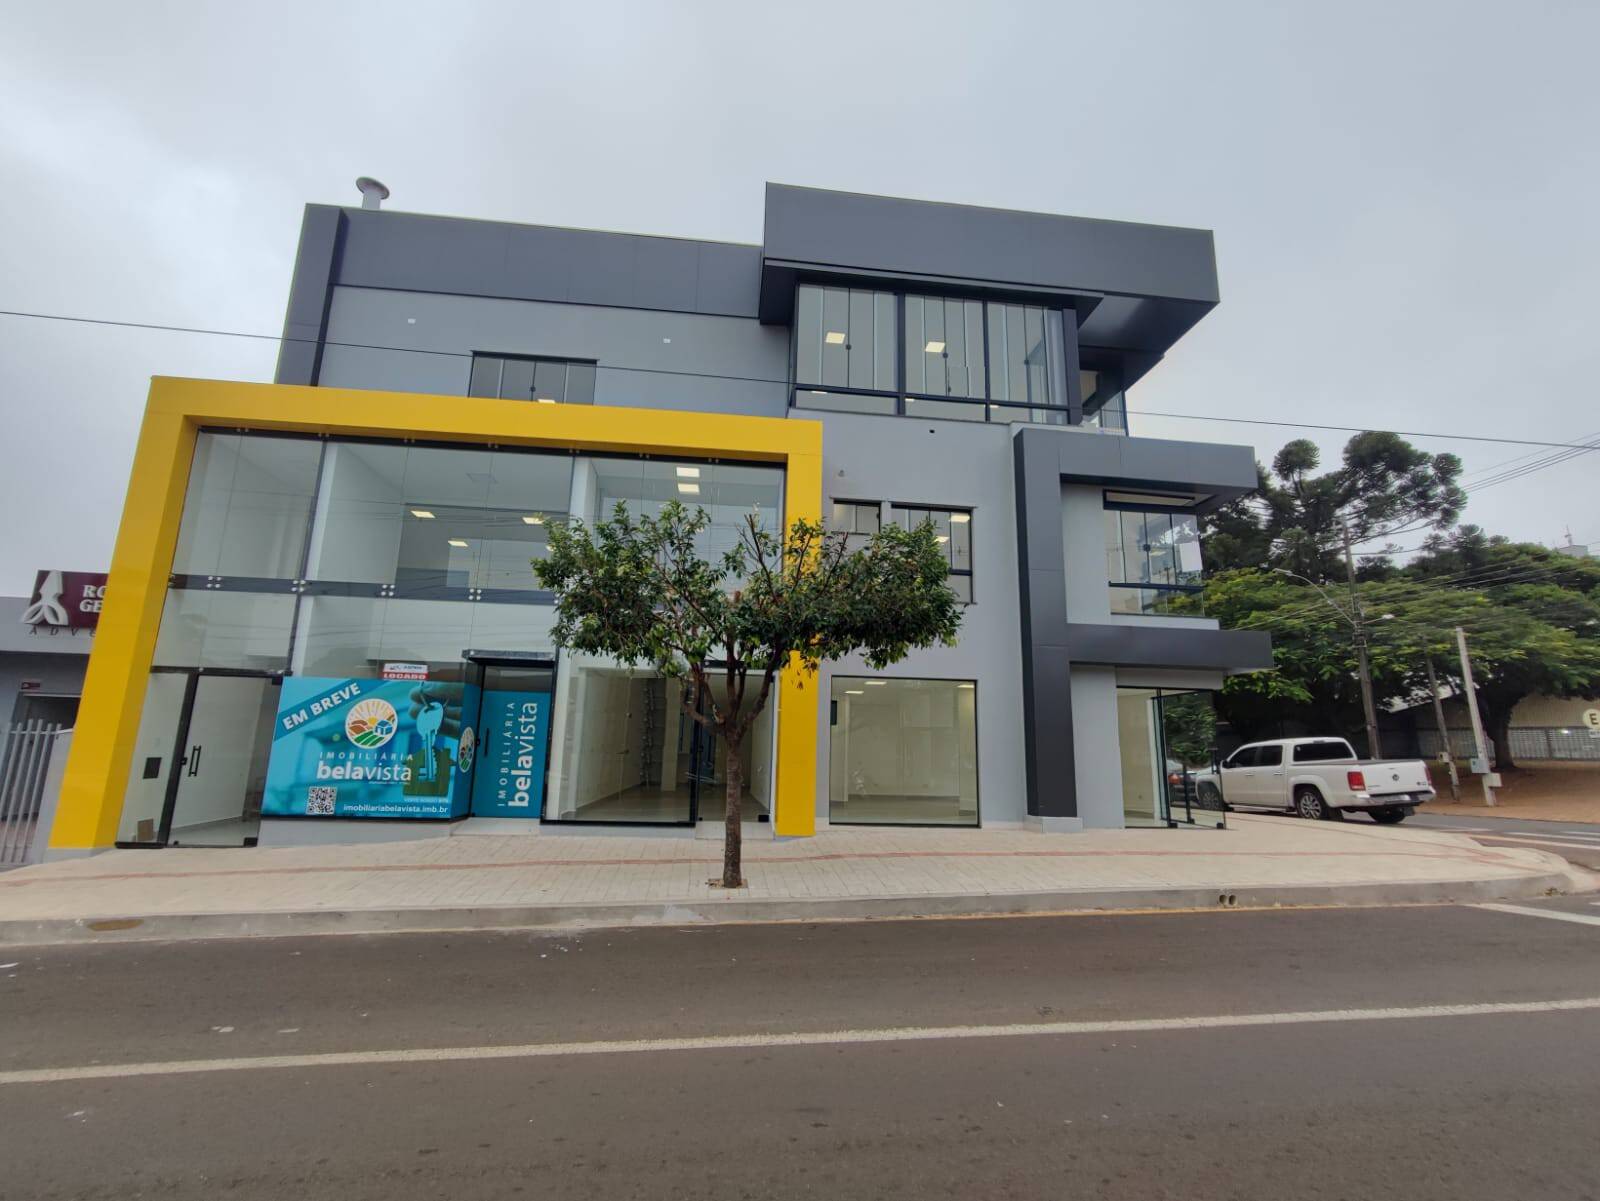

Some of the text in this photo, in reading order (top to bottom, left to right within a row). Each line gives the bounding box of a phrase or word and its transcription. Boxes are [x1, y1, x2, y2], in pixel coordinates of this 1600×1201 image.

[383, 672, 426, 680] LOCADO
[282, 682, 361, 731] EM BREVE
[508, 702, 538, 807] belavista
[316, 761, 412, 782] belavista
[343, 803, 448, 815] imobiliariabelavista.imb.br
